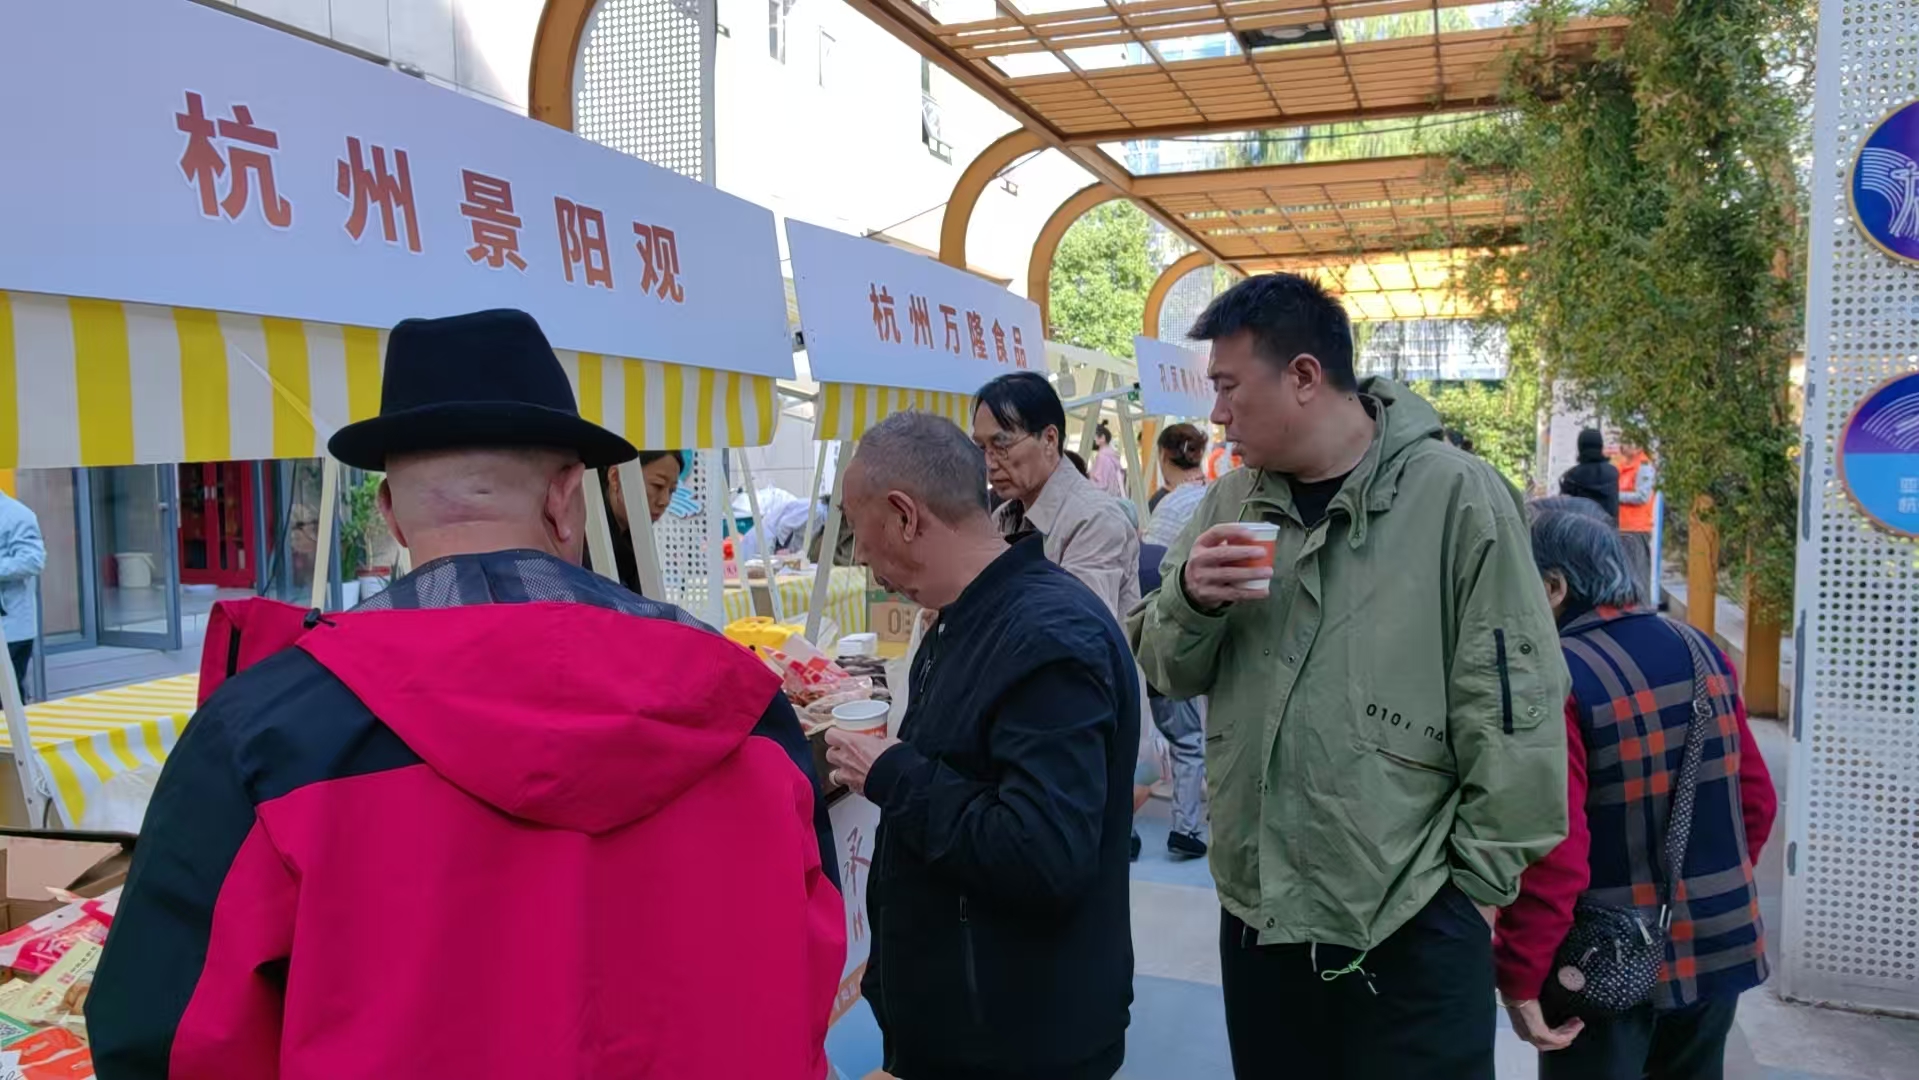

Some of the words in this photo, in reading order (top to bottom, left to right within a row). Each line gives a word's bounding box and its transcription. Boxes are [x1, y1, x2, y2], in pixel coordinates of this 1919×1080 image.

[174, 90, 686, 305] 杭州景阳观
[869, 282, 1028, 369] 杭州万隆食品
